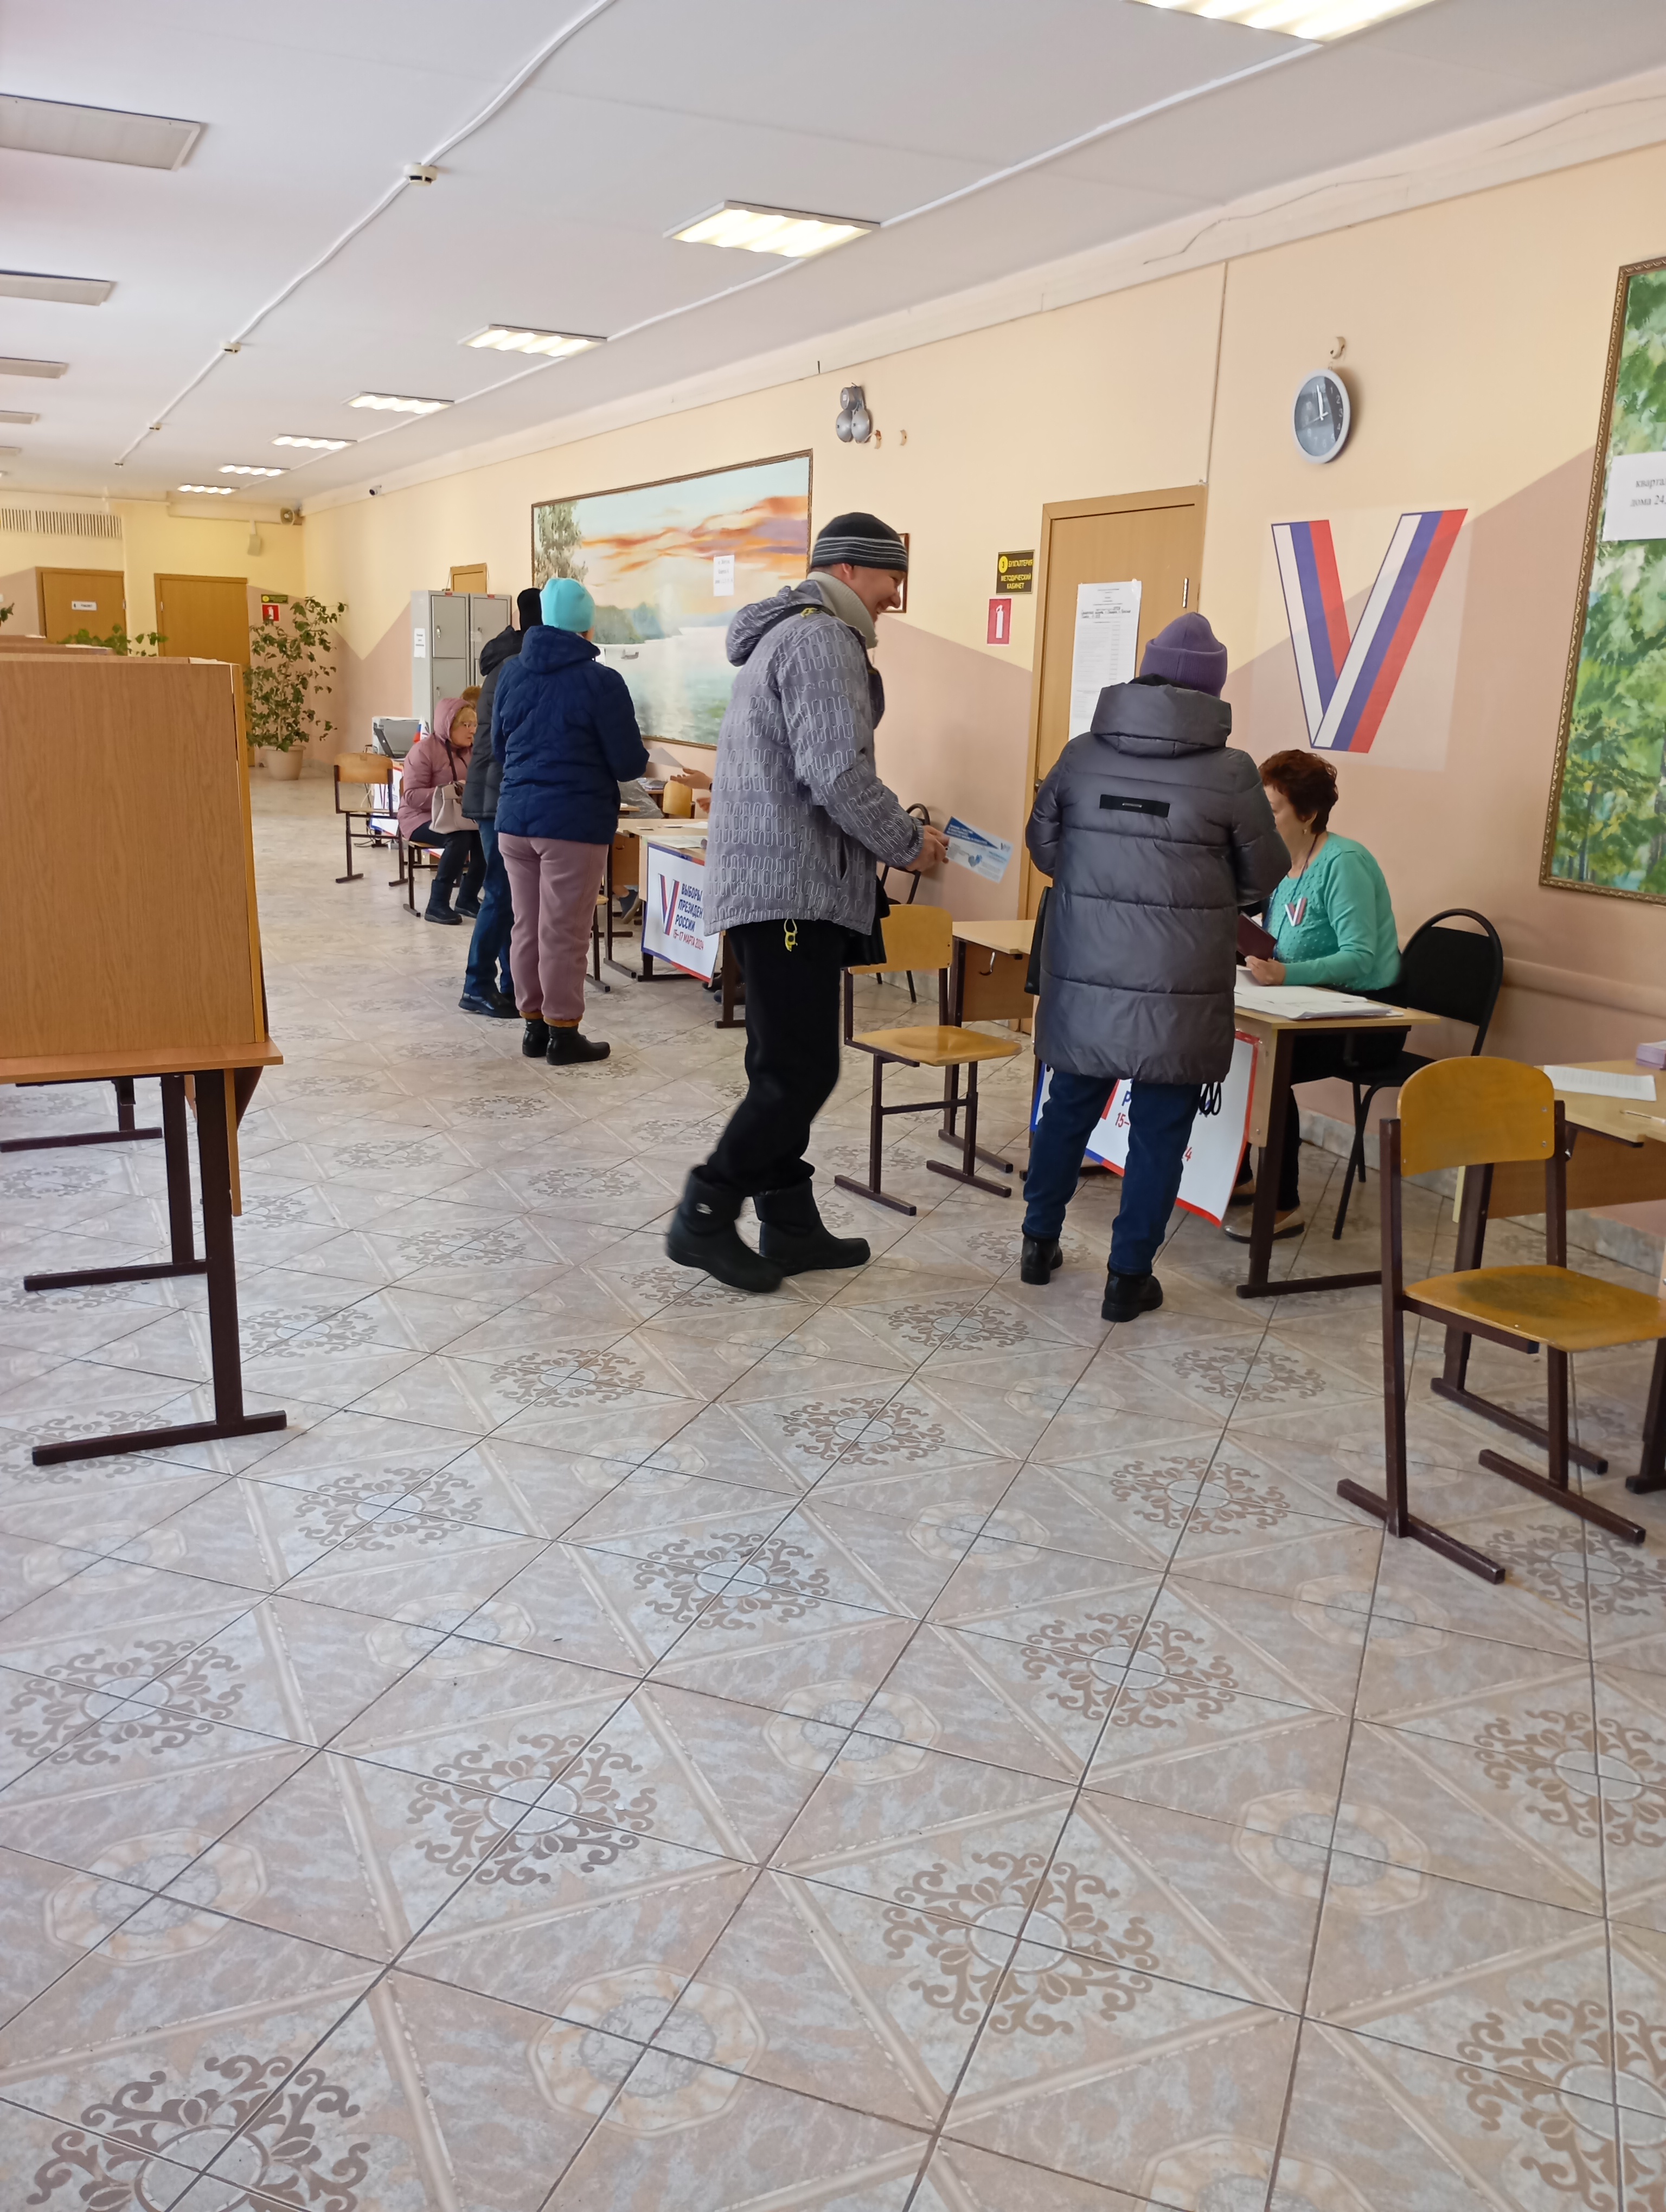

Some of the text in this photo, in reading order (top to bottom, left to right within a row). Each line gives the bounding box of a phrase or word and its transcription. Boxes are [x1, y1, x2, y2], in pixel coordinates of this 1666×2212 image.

[1336, 395, 1341, 404] 2
[1338, 408, 1343, 417] 3
[1636, 478, 1666, 489] кварта
[681, 883, 703, 902] ВЫБОРЫ
[678, 899, 703, 919] ПРЕЗИДЕН
[675, 914, 696, 932] РОССИИ
